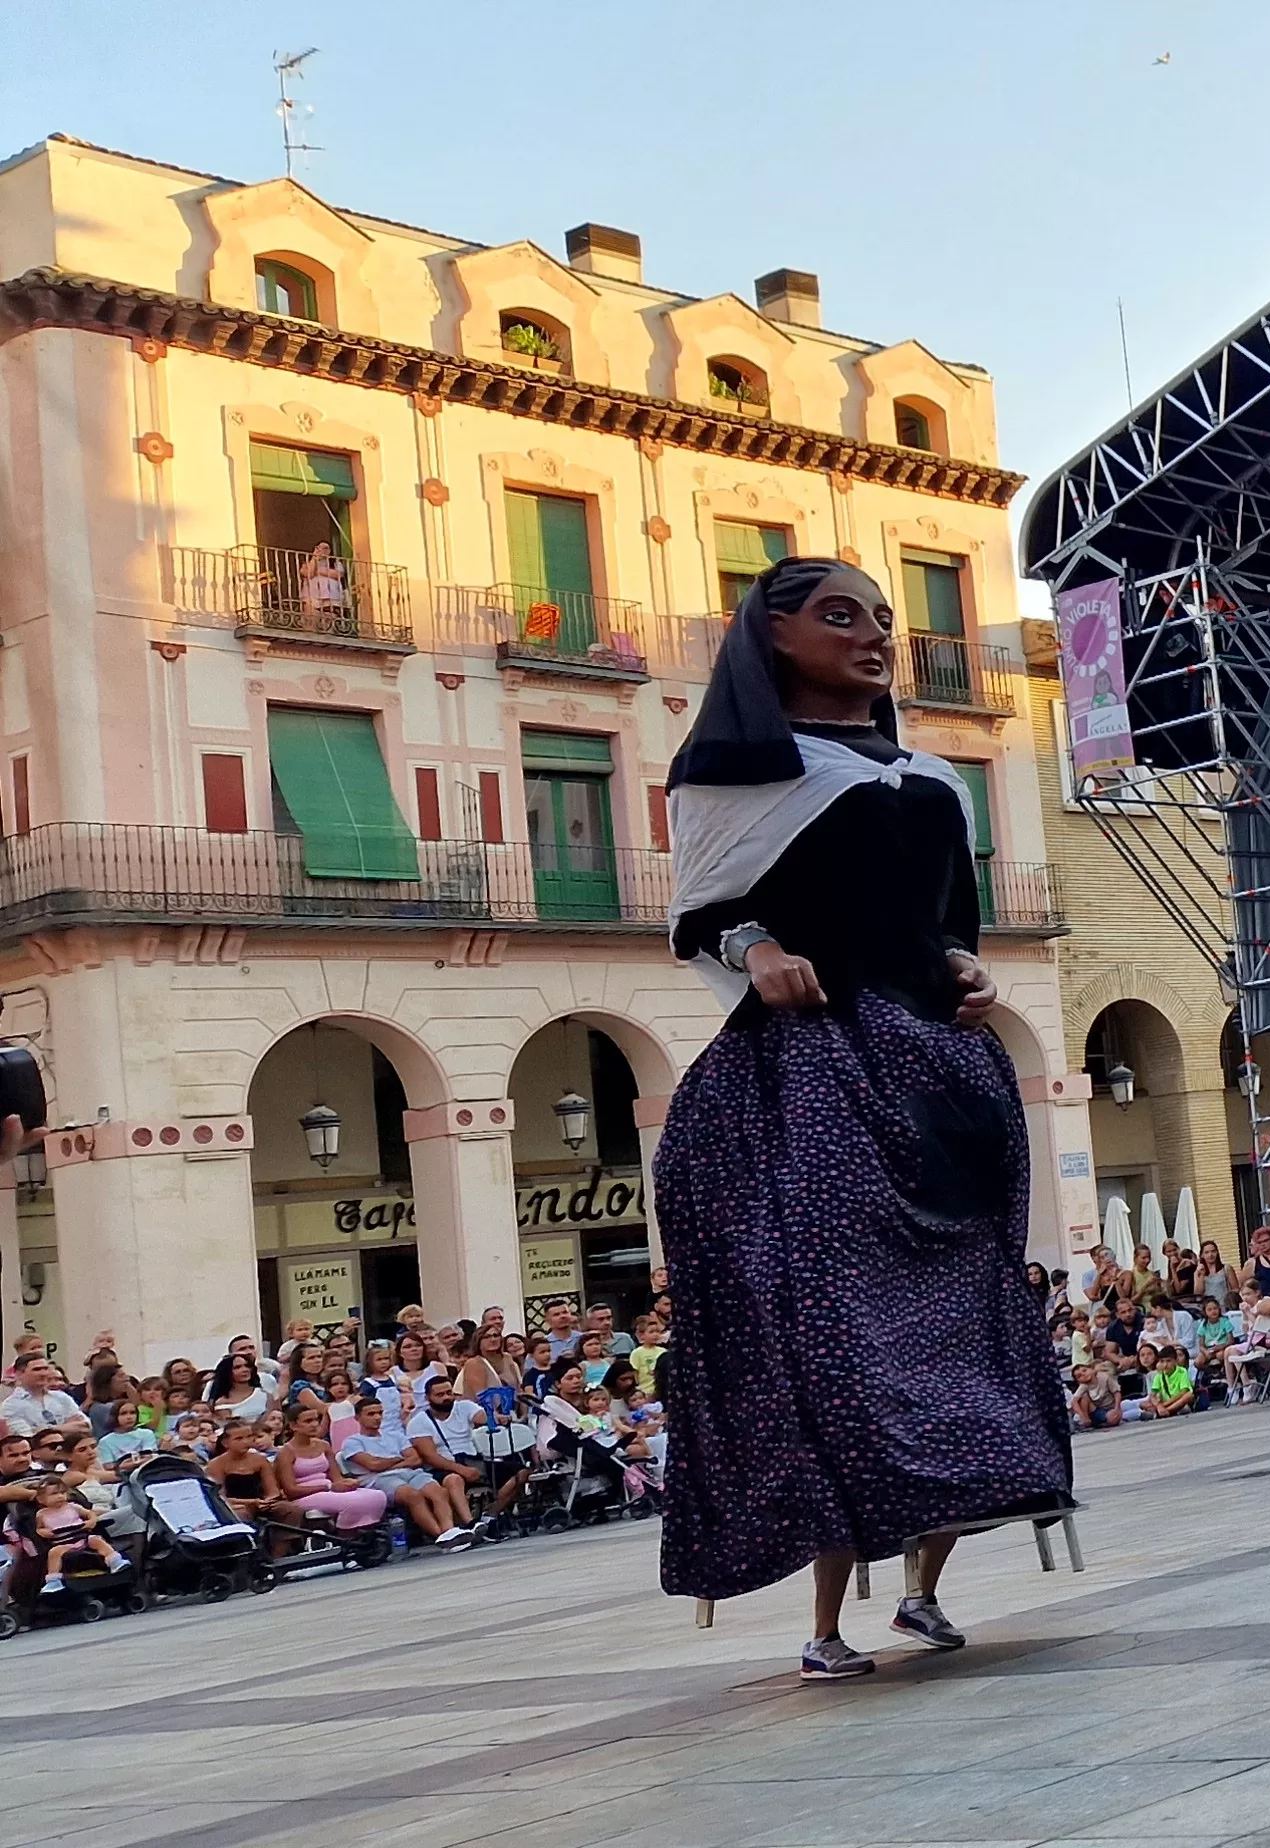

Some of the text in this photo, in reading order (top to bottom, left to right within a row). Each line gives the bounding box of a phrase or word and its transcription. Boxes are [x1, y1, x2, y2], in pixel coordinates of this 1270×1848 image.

[1067, 600, 1111, 624] VIOLETA
[299, 1284, 328, 1295] PERO
[321, 1295, 339, 1308] LL
